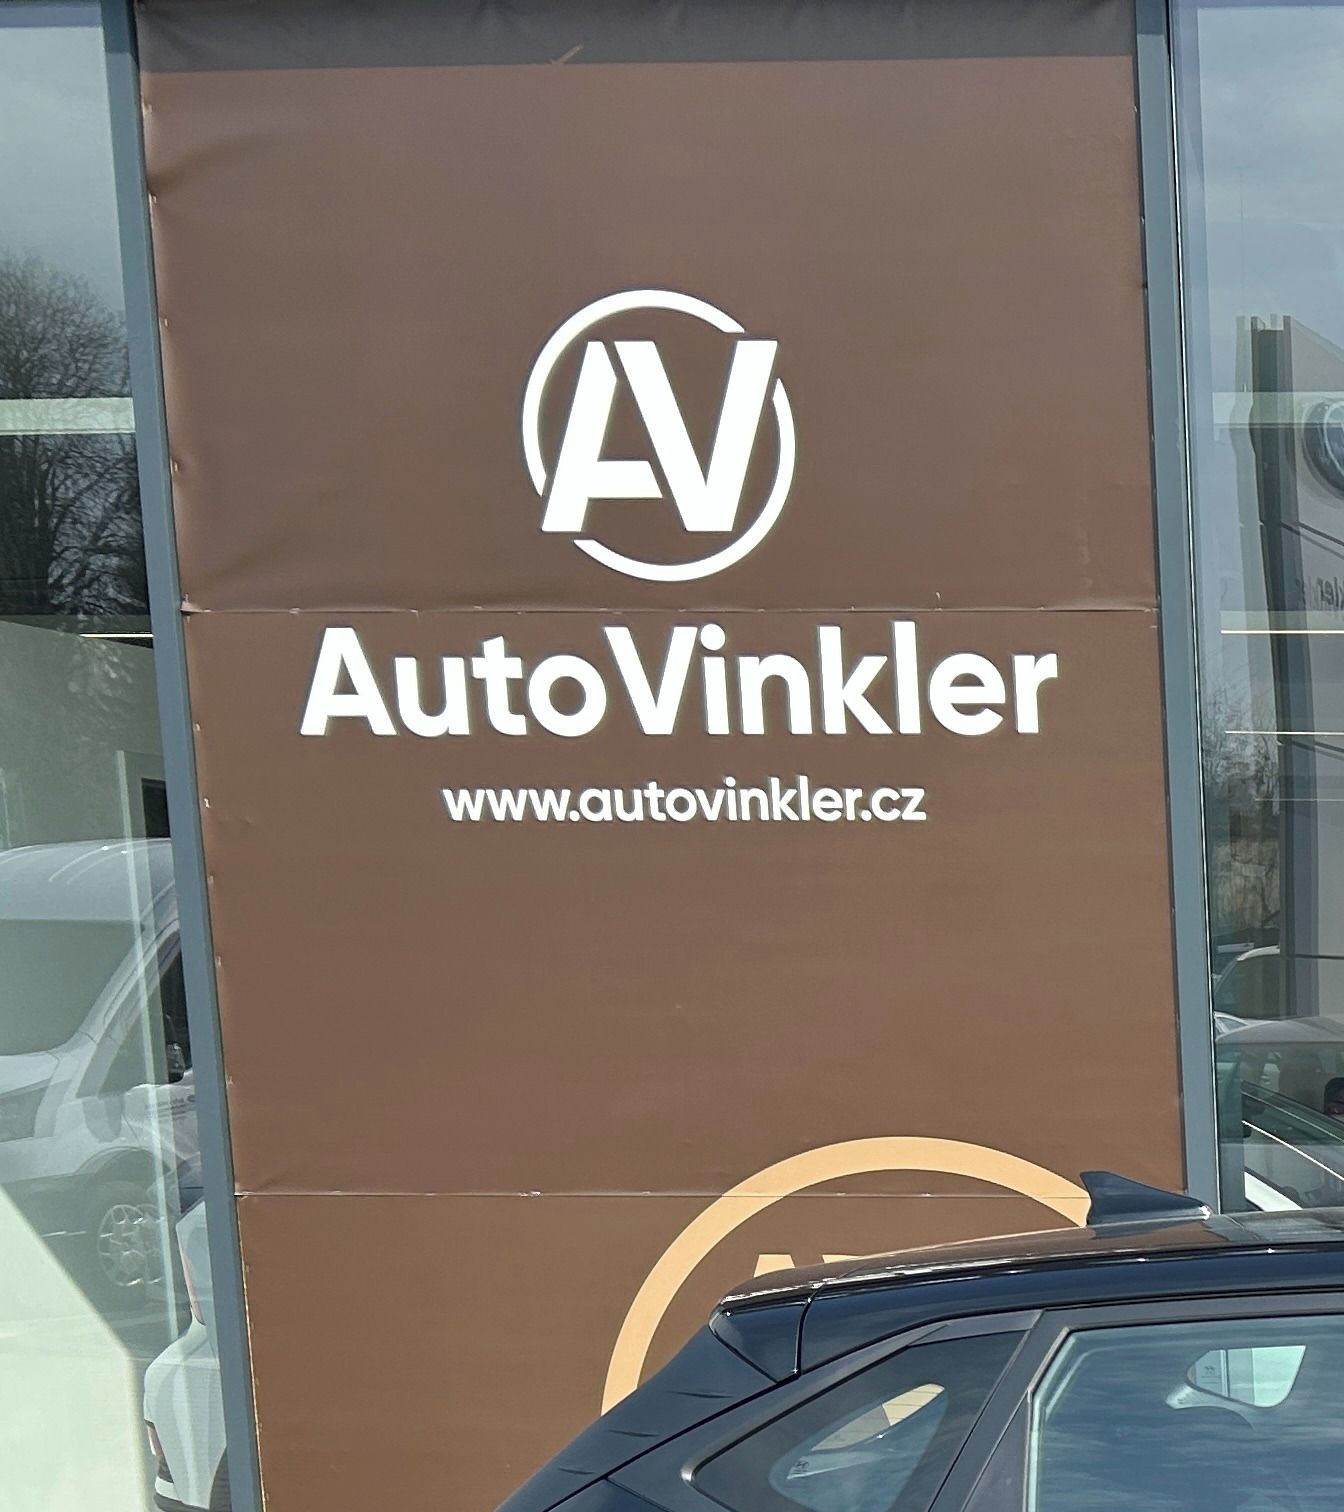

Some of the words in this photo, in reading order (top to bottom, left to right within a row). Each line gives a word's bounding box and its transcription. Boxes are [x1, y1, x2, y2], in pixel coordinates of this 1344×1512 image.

[541, 339, 779, 533] AV
[299, 620, 1059, 739] AutoVinkler
[441, 775, 928, 824] www.autovinkler.cz
